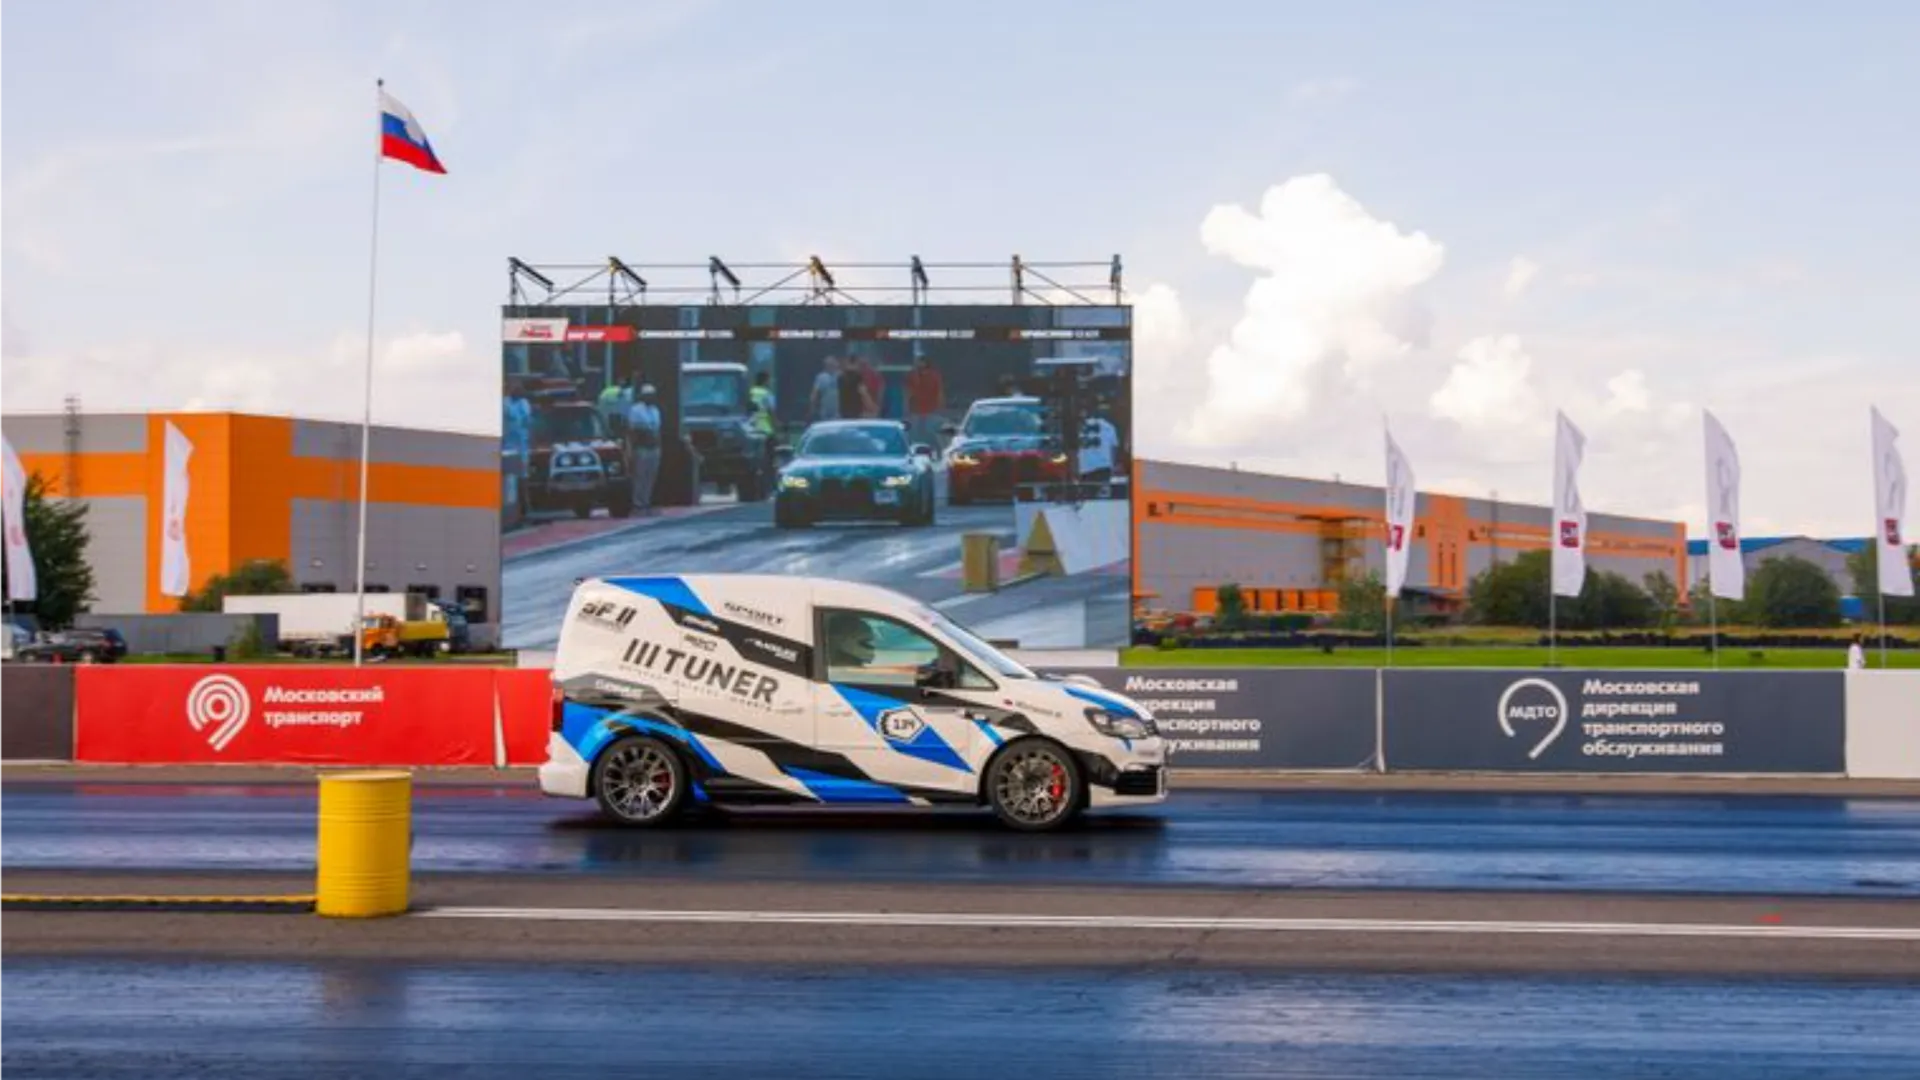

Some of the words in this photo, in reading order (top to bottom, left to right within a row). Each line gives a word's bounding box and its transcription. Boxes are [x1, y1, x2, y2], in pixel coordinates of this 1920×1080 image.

[1126, 676, 1238, 692] Московская
[1582, 679, 1699, 695] Московская
[263, 685, 384, 703] Московский
[1509, 705, 1558, 719] МДТО
[1581, 702, 1678, 717] дирекция
[263, 711, 364, 728] транспорт
[1582, 722, 1724, 737] транспортного
[1167, 739, 1259, 754] уживания
[1582, 740, 1723, 757] обслуживания
